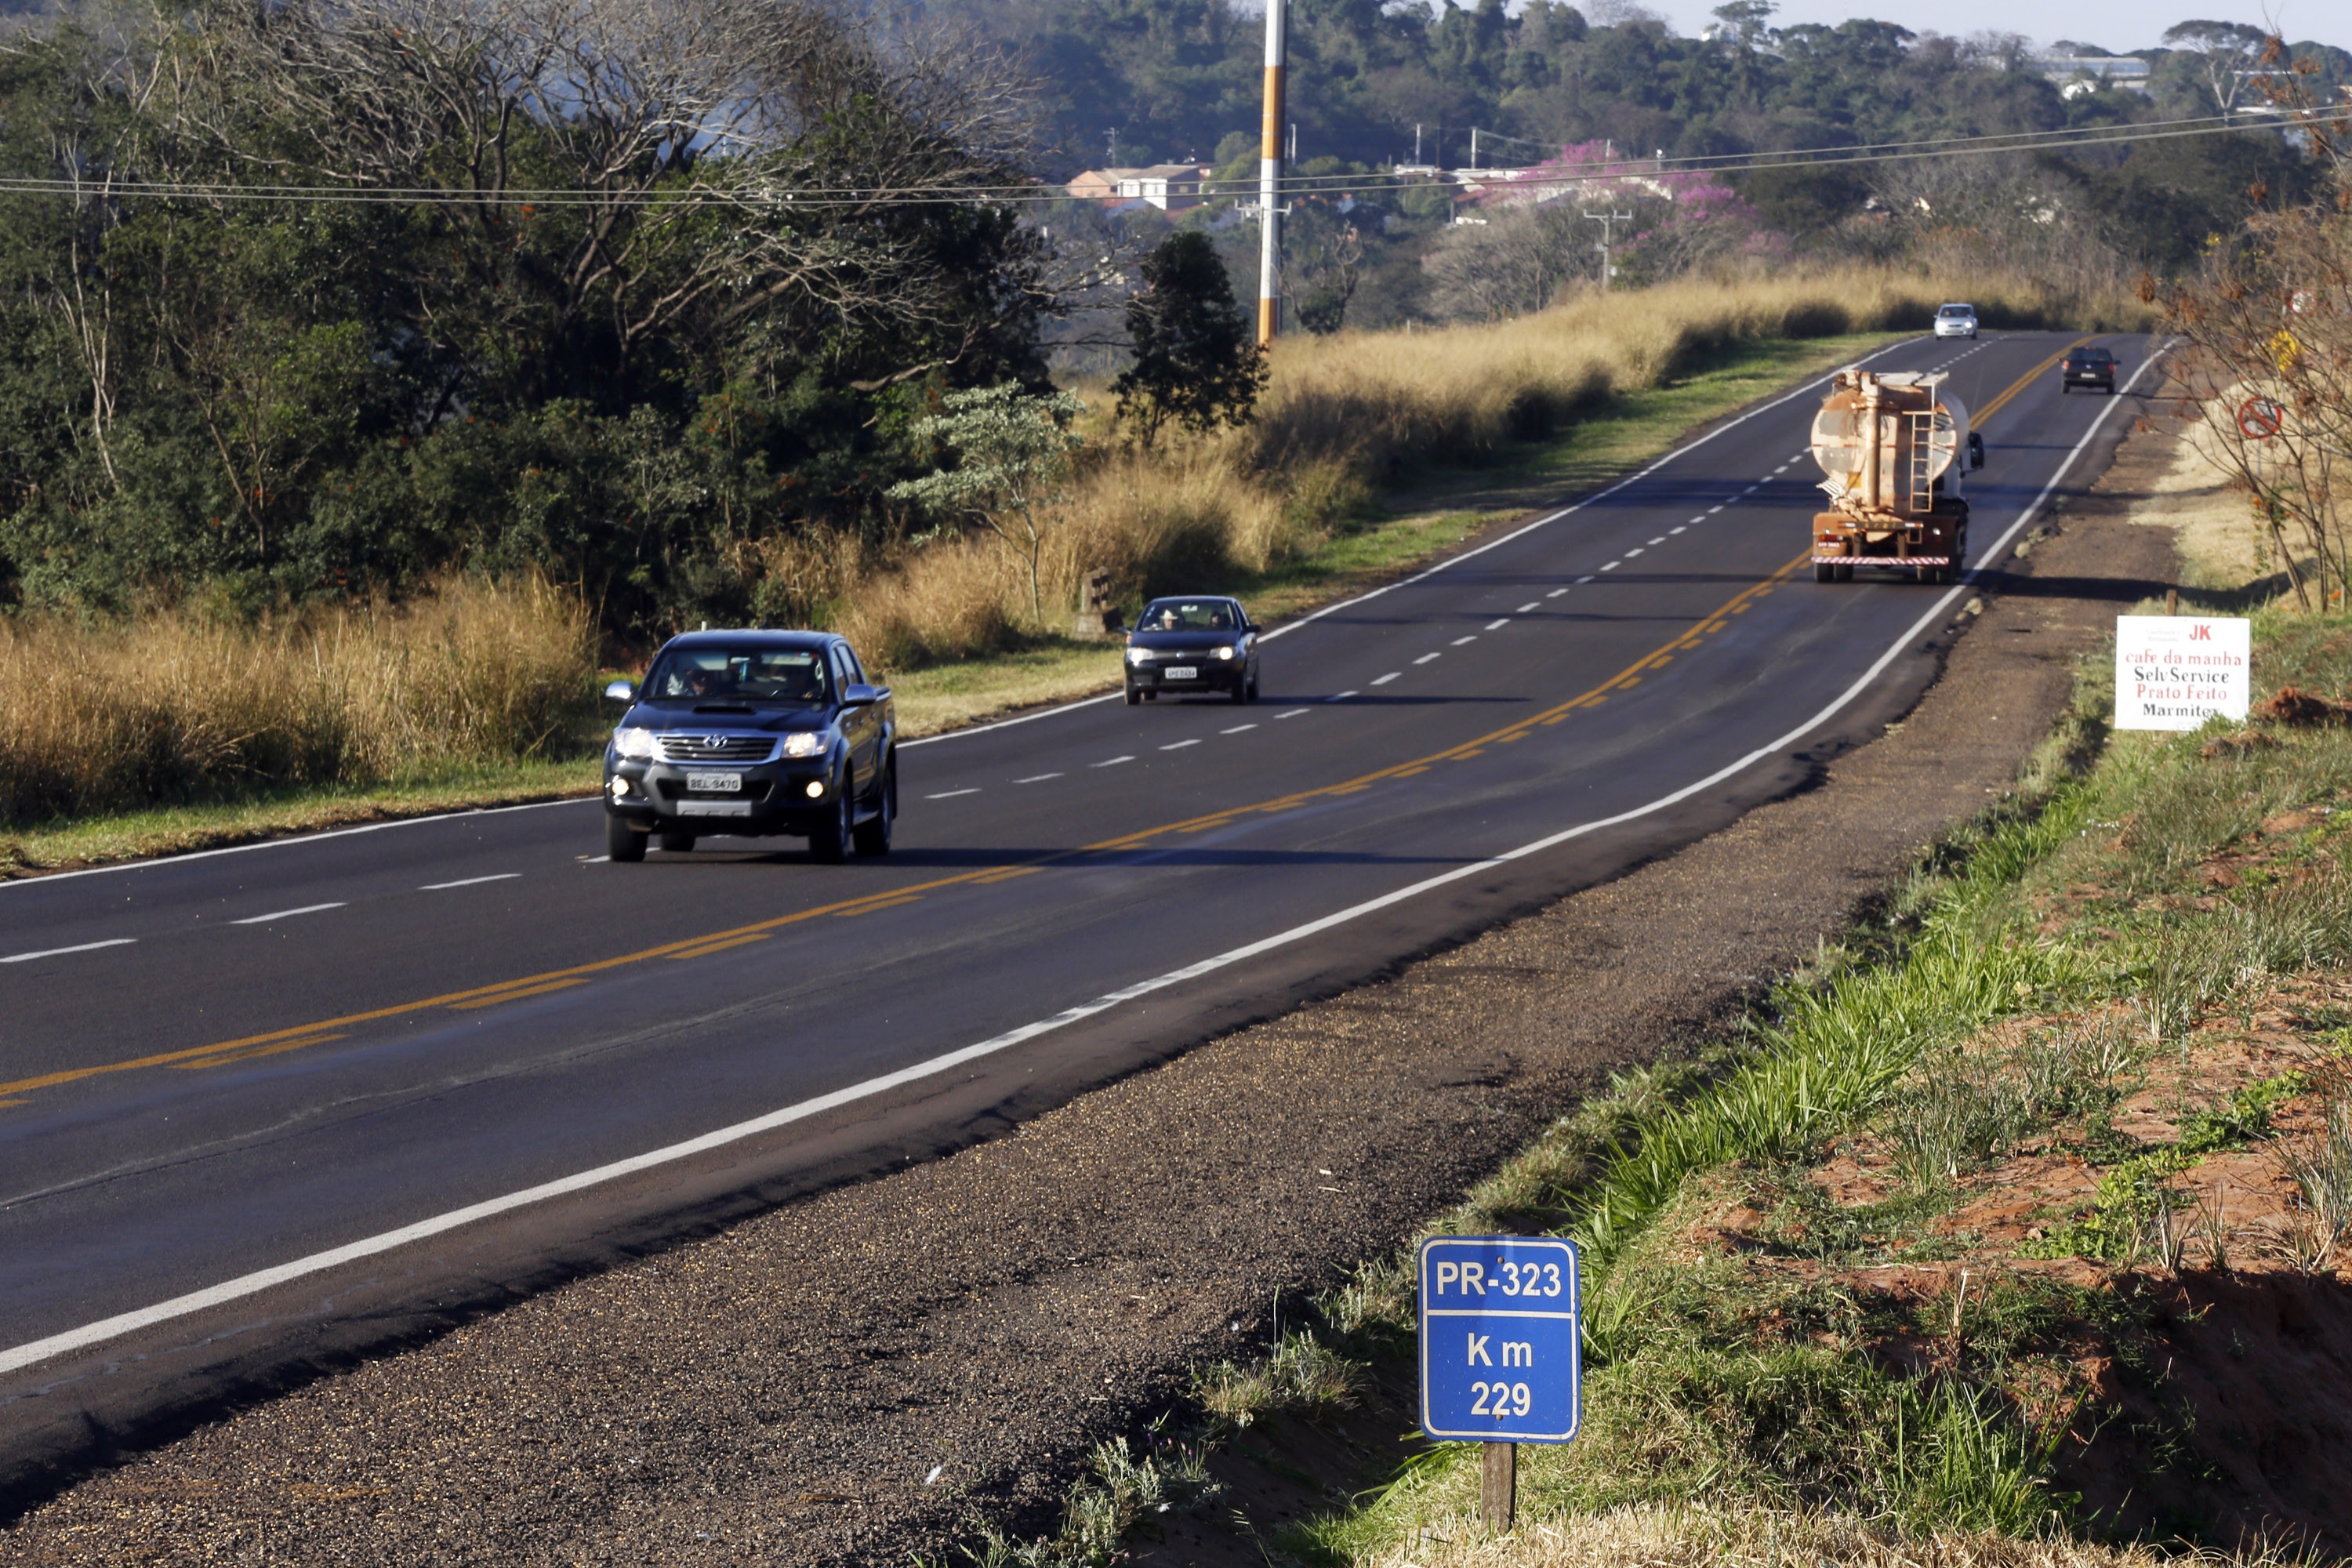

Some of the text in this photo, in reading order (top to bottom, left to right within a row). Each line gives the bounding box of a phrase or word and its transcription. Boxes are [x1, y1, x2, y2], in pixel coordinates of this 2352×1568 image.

[2189, 625, 2212, 641] JK
[2125, 648, 2241, 666] cafe da manha
[2134, 666, 2230, 684] Selv Service
[2137, 683, 2227, 700] Prato Feito
[1437, 1261, 1562, 1298] PR-323
[1471, 1381, 1531, 1417] 229
